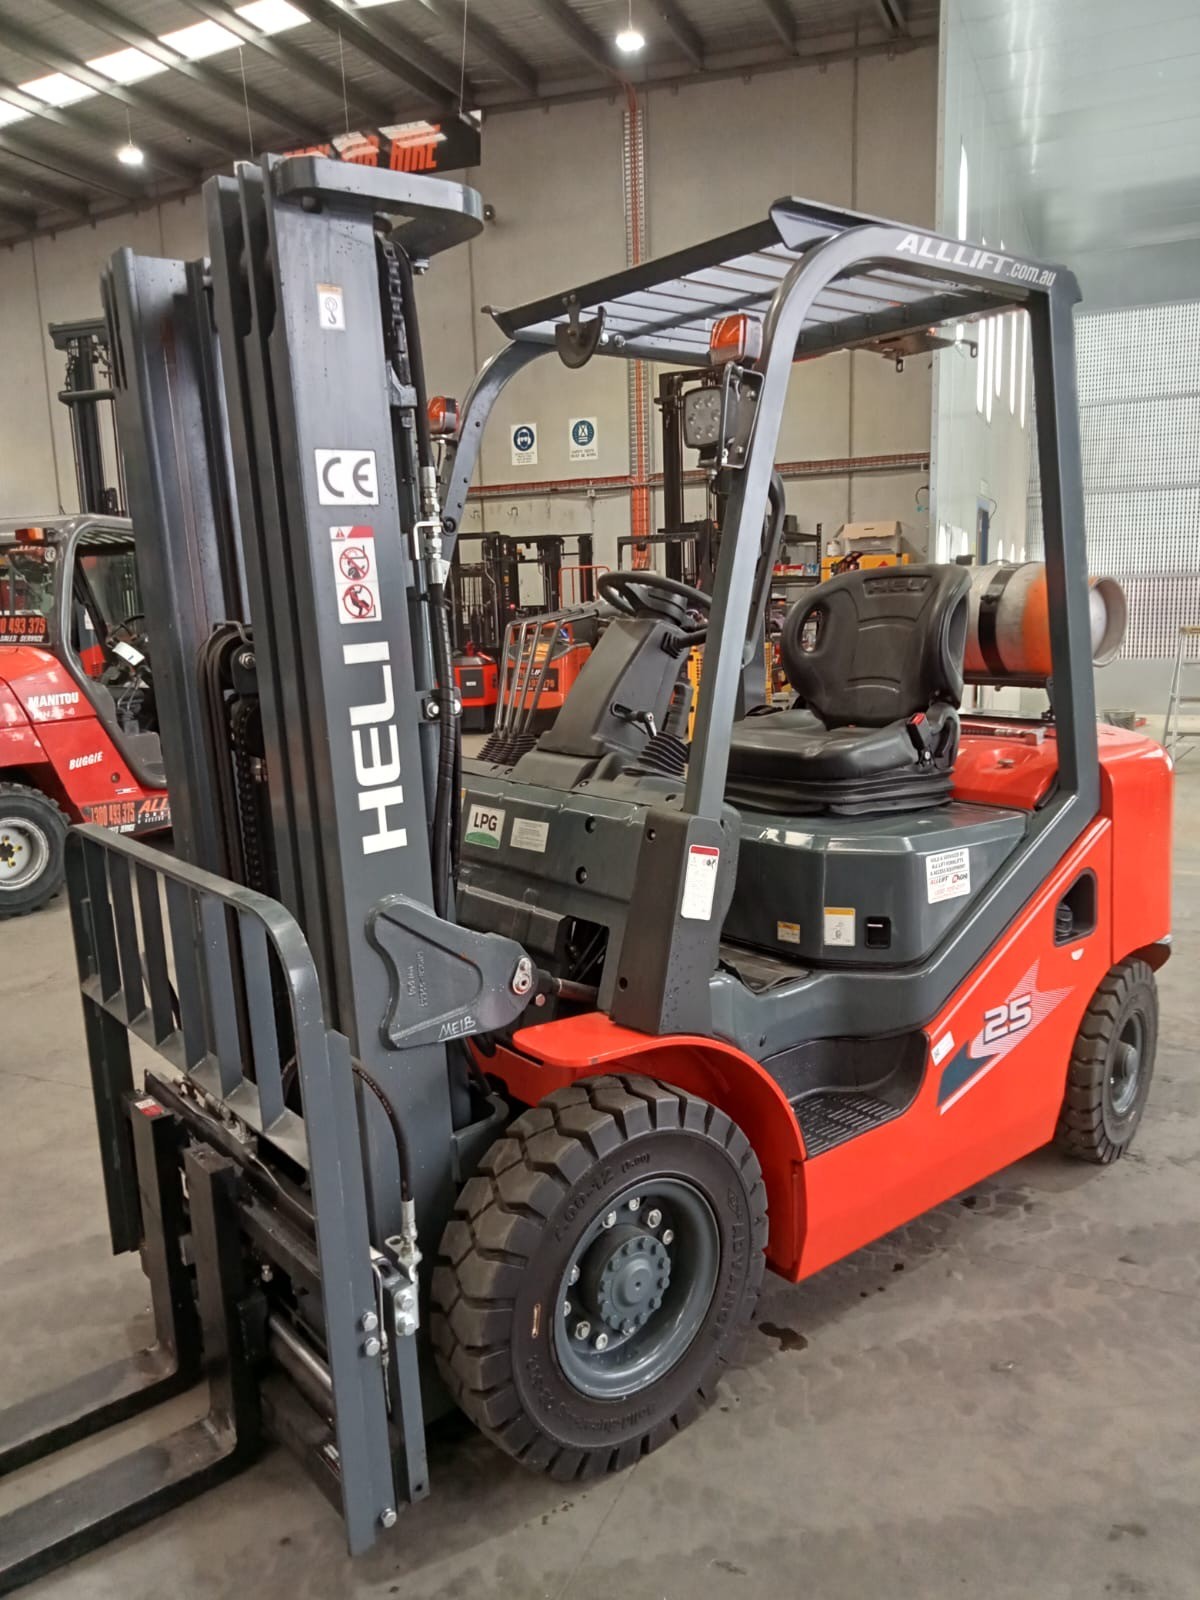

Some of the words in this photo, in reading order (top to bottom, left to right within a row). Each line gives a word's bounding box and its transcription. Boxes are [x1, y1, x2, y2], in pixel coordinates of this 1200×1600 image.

[896, 233, 1057, 287] ALLLIFT.com.au
[9, 616, 26, 633] 493
[28, 616, 46, 633] 375
[28, 691, 80, 709] MANITOU
[342, 640, 408, 855] HELI
[69, 751, 104, 771] BUGGIE
[473, 812, 498, 831] LPG
[983, 991, 1032, 1045] 25
